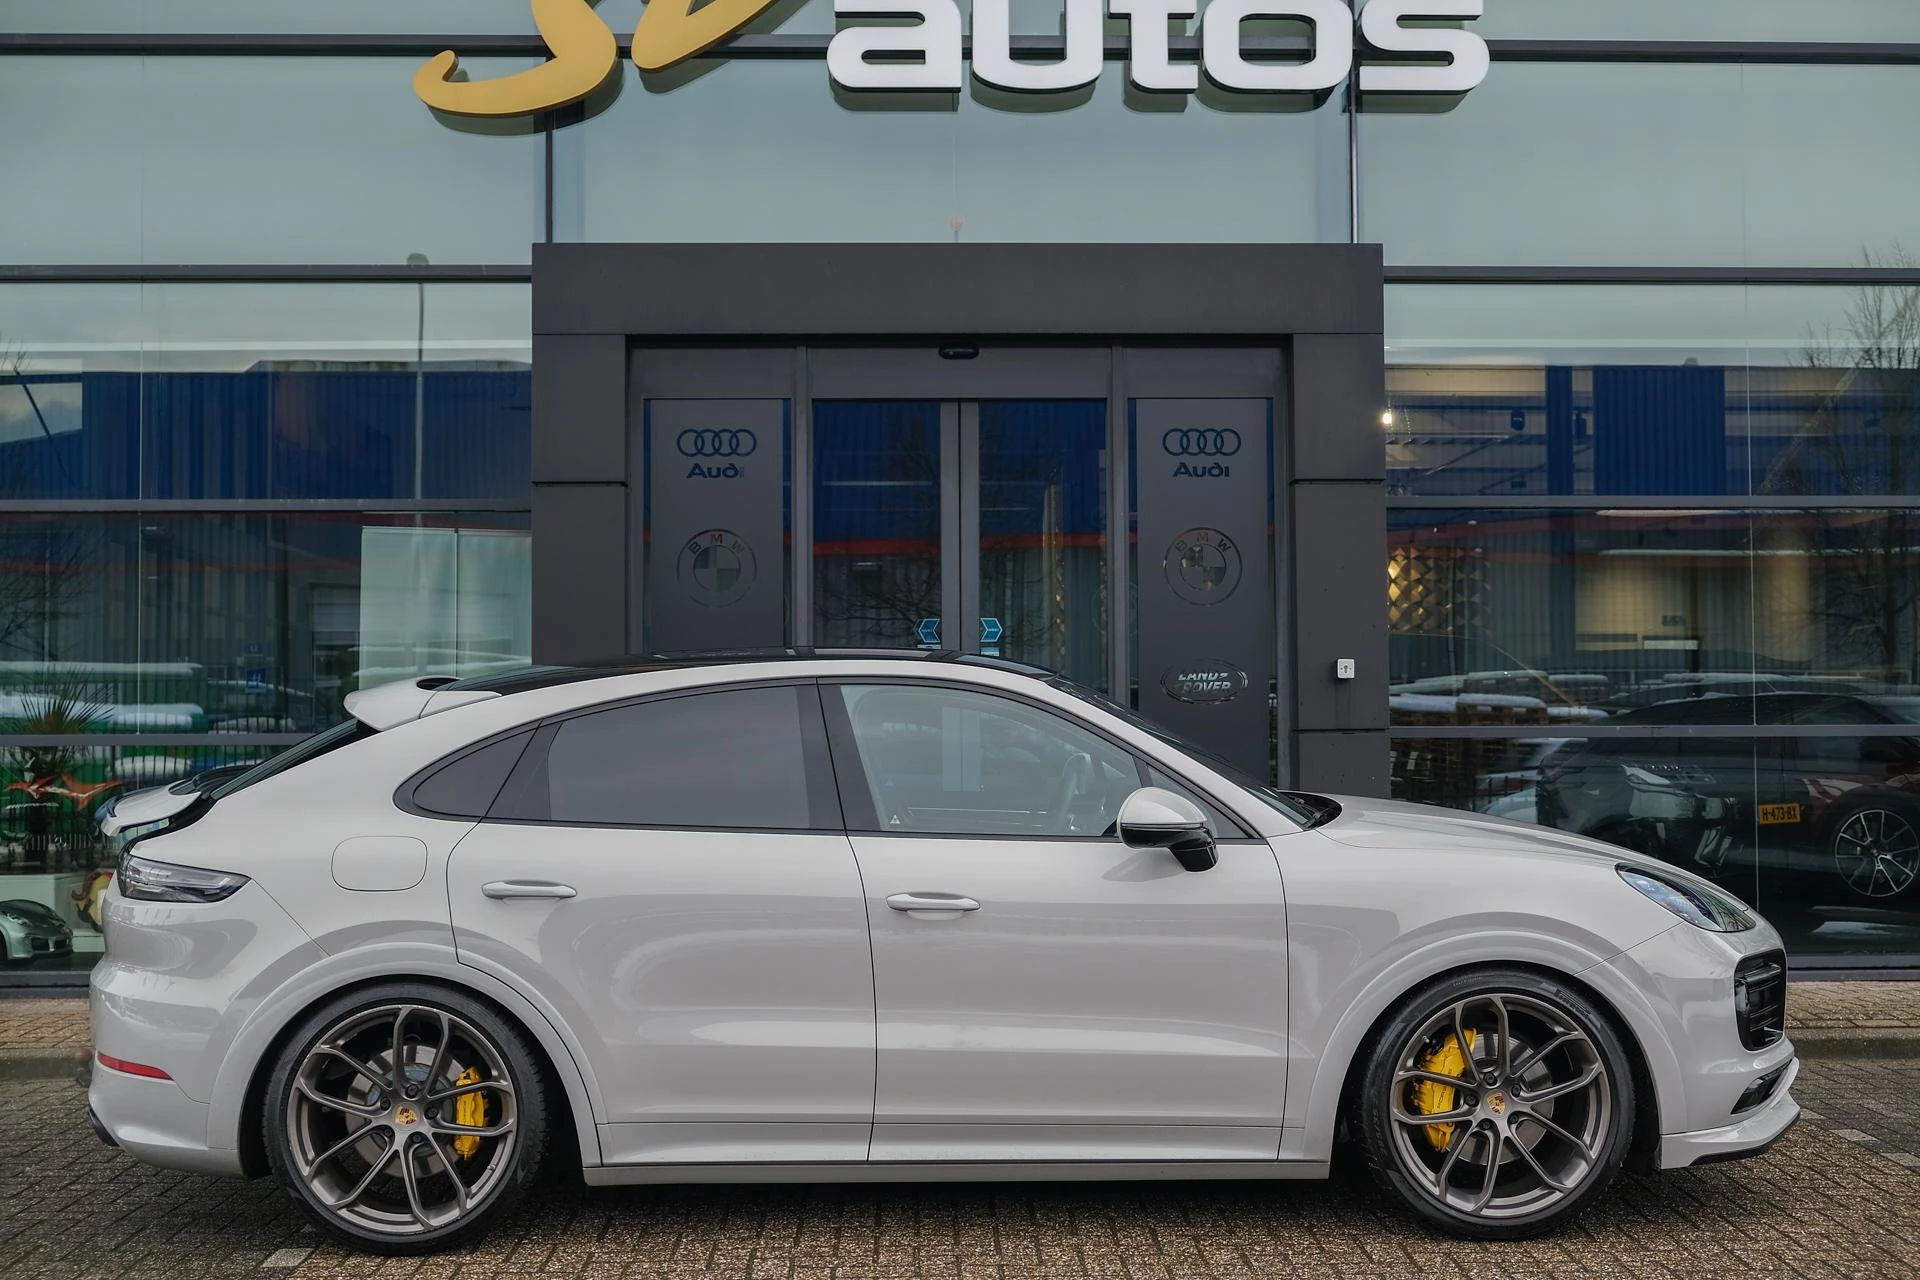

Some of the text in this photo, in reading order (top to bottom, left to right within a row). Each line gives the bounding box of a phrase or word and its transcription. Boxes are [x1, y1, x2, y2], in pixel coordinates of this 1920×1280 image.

[826, 0, 1490, 92] autos
[1172, 462, 1230, 477] Audi
[1175, 531, 1232, 553] BMW
